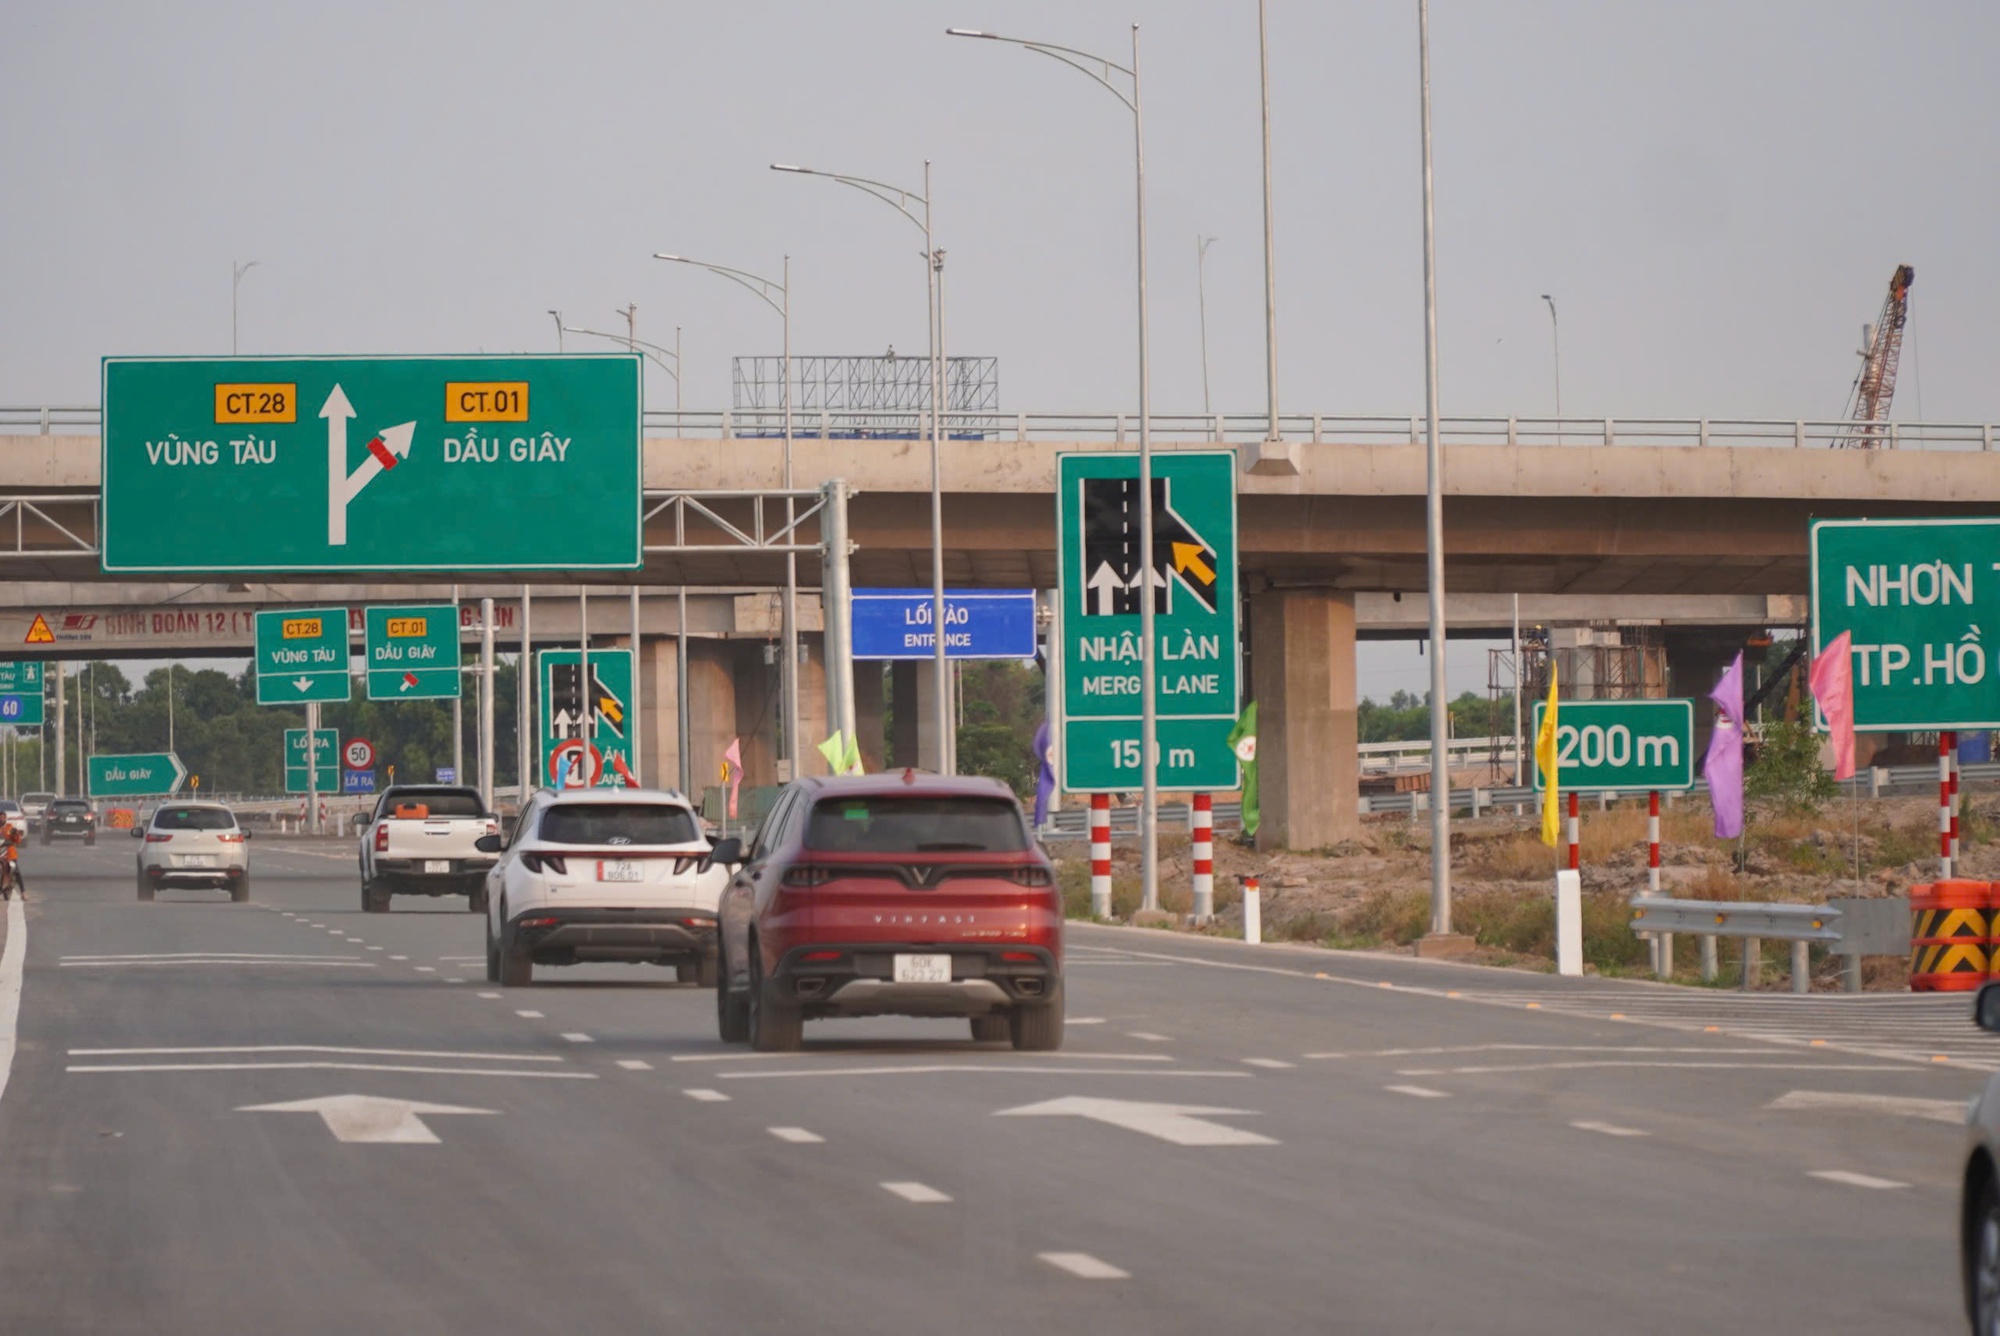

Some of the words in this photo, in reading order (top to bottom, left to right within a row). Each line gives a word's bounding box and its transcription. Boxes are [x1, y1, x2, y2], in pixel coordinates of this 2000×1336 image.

[226, 392, 285, 415] CT.28
[460, 390, 519, 414] CT.01
[146, 434, 219, 466] VŨNG
[230, 434, 277, 465] TÀU
[444, 426, 499, 462] DẦU
[510, 431, 571, 462] GIÂY
[1846, 559, 1973, 607] NHƠN
[205, 612, 225, 632] 12
[905, 602, 932, 625] LỐI
[943, 603, 969, 625] ÀO
[286, 622, 319, 636] CT.28
[390, 621, 424, 635] CT.01
[904, 633, 972, 648] ENTRNCE
[1162, 628, 1219, 661] LÀN
[271, 647, 308, 664] VŨNG
[311, 646, 336, 663] TÀU
[375, 641, 402, 661] DẦU
[408, 644, 437, 660] GIÂY
[1852, 624, 1986, 686] TP.HỒ
[1162, 674, 1219, 695] LANE
[2, 700, 18, 716] 60
[351, 747, 367, 762] 50
[1168, 748, 1195, 768] m
[360, 776, 374, 787] RA
